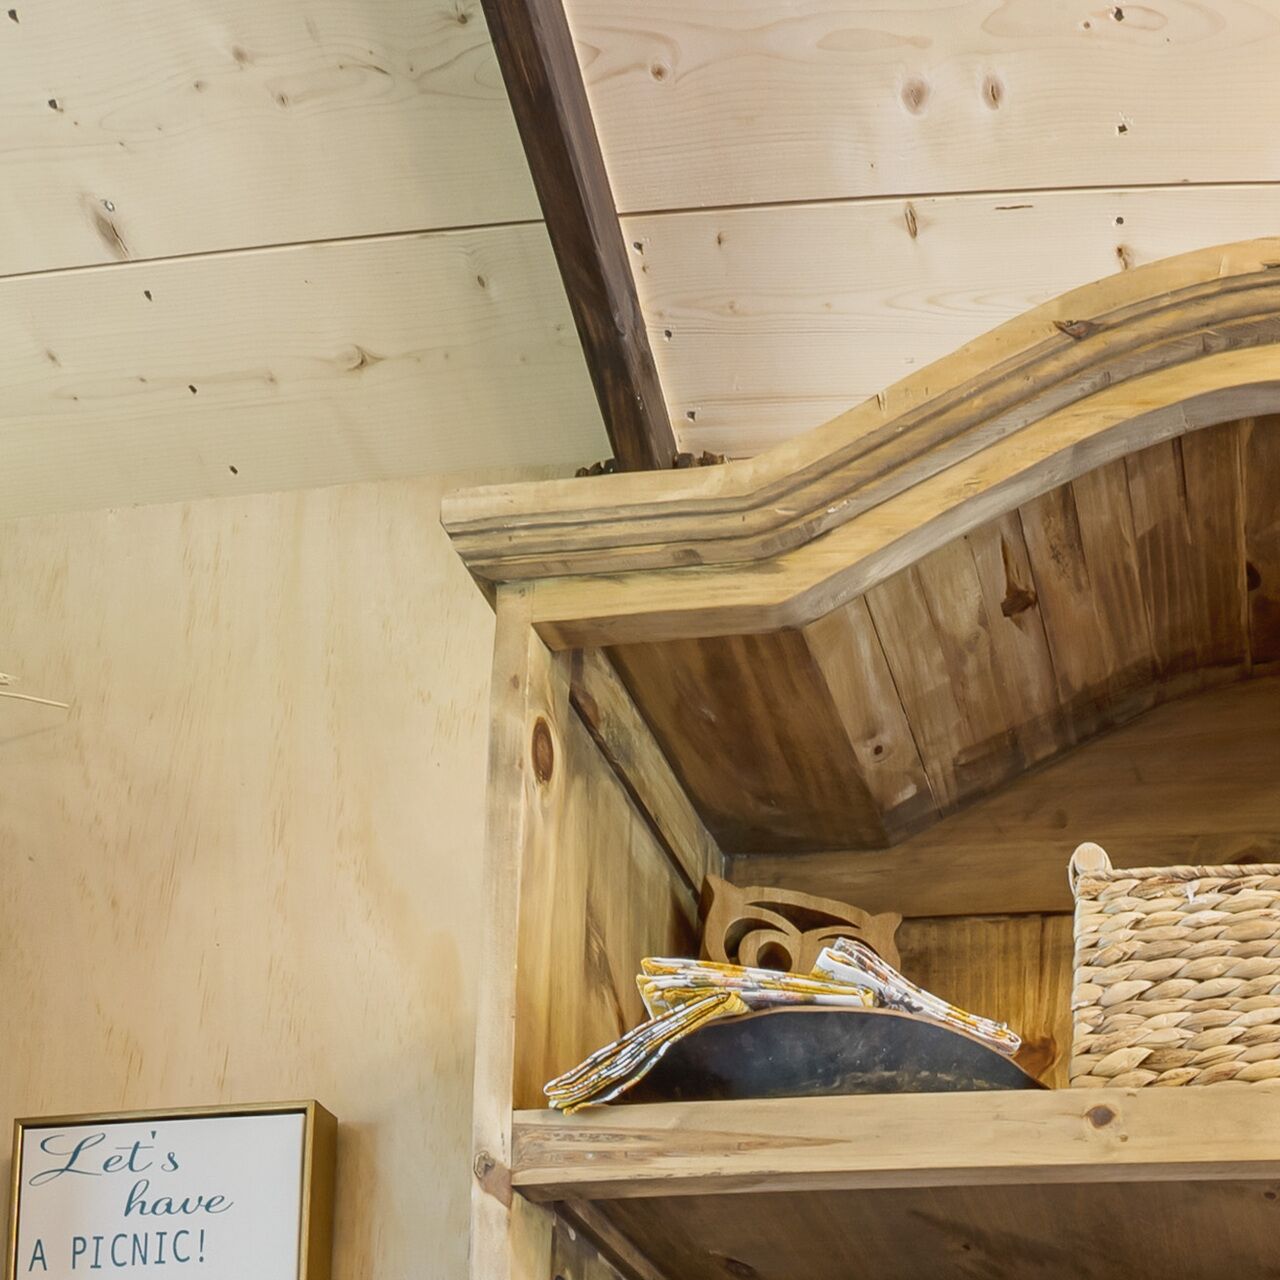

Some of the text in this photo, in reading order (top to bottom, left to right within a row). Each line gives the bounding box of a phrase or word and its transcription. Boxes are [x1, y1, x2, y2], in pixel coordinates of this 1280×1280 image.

[29, 1130, 180, 1187] Let's
[123, 1179, 234, 1217] have
[28, 1229, 206, 1271] A PICNIC!
